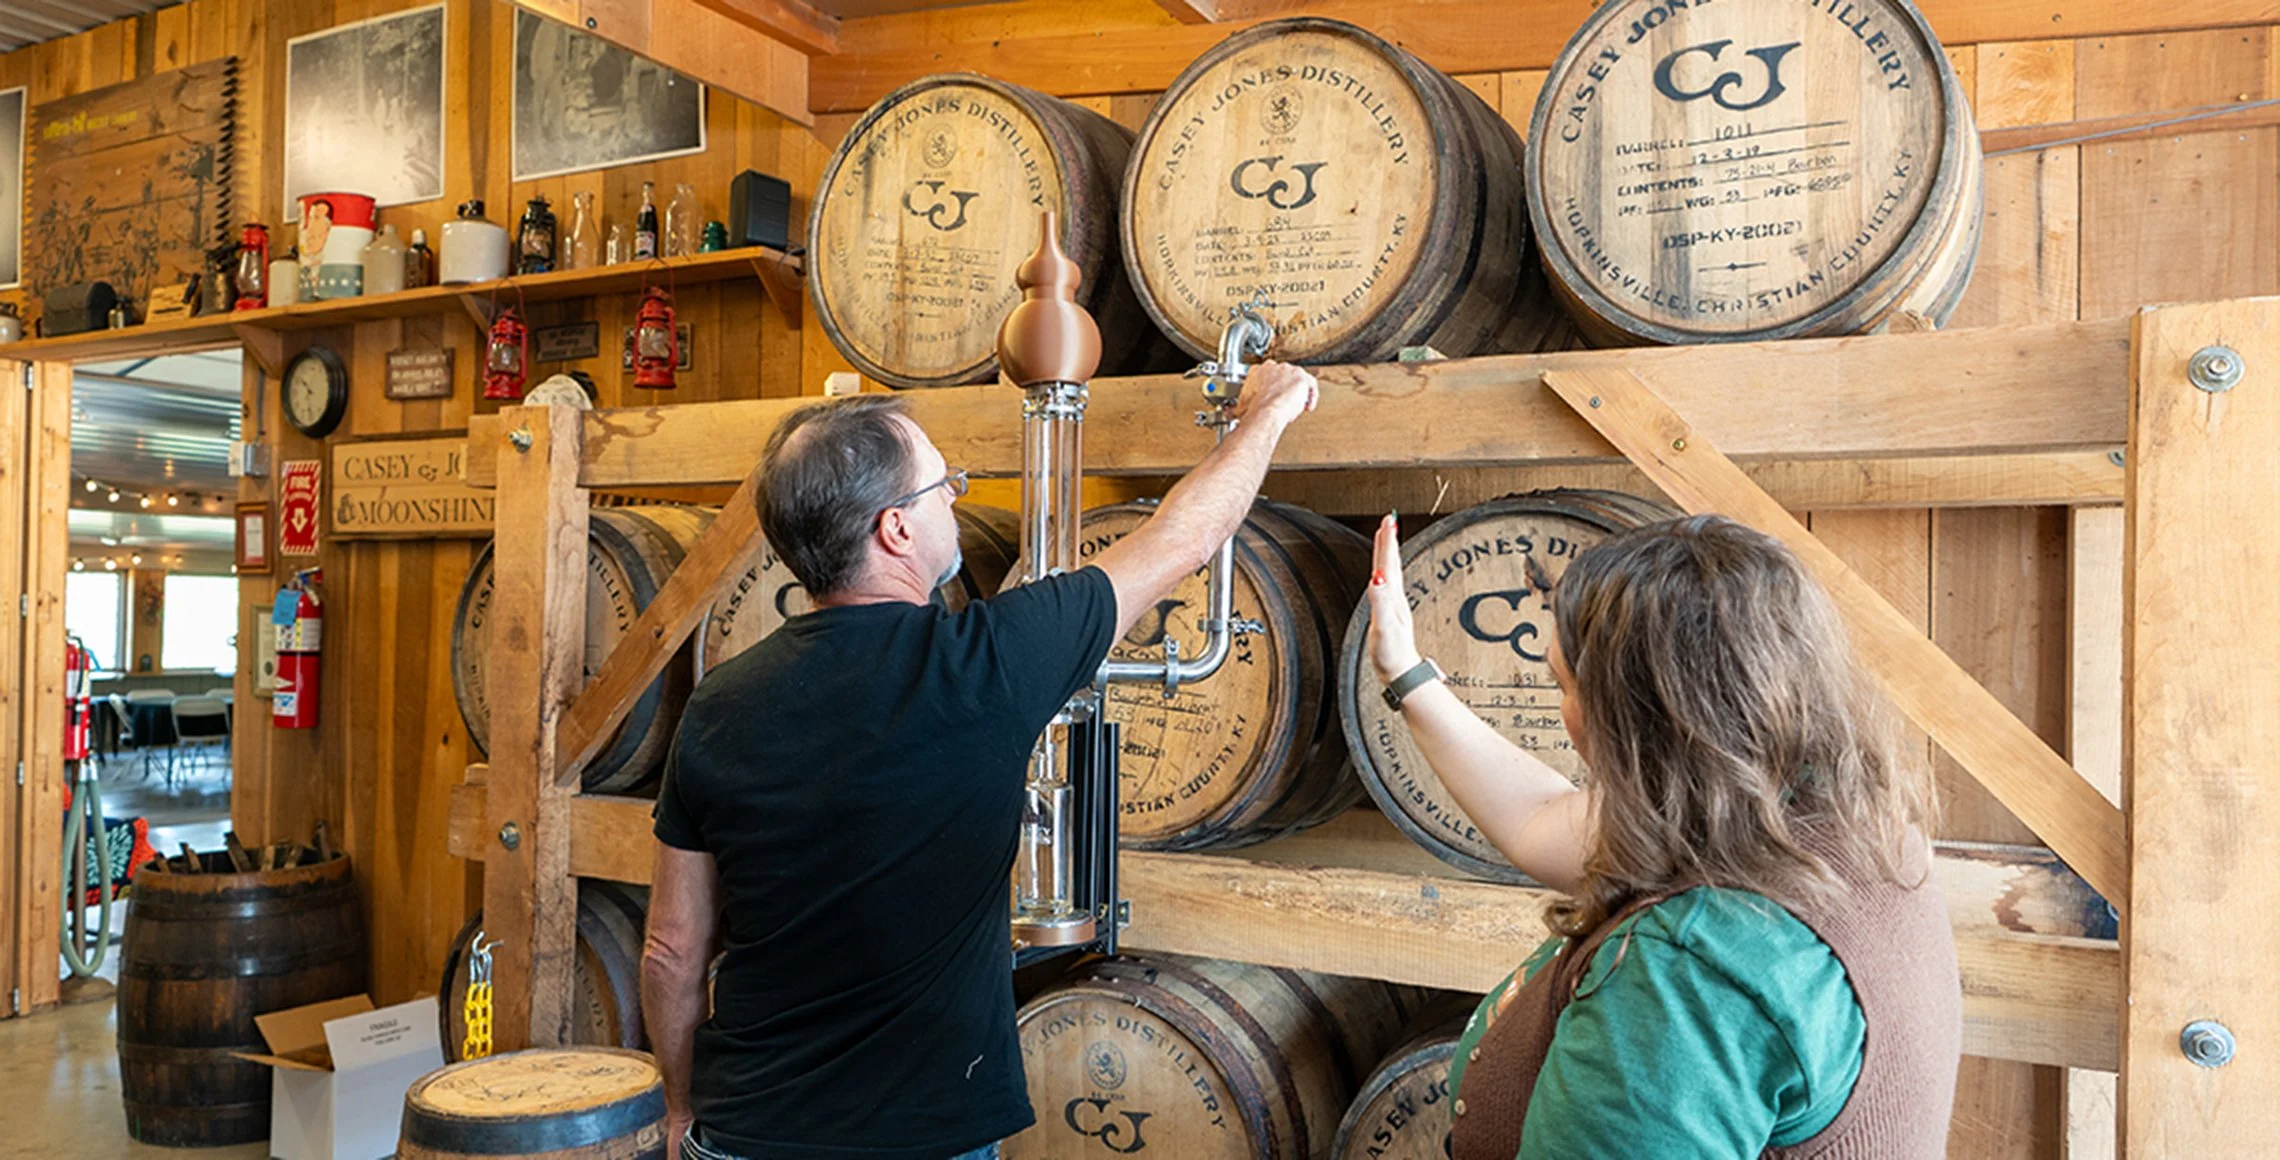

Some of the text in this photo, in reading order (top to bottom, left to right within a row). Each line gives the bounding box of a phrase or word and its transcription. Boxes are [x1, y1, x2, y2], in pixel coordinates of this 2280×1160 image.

[1561, 0, 1910, 143] CASEY JON ILLERY
[1653, 39, 1802, 111] CJ
[845, 99, 1044, 207] CASEY JONES DISTILLERY
[1159, 65, 1409, 191] CASEY JONES DISTILLERY
[902, 180, 980, 232] CJ
[1231, 155, 1328, 210] CJ
[1393, 213, 1406, 236] KY
[1696, 271, 1824, 313] CHRISTIAN
[1893, 151, 1912, 178] KY
[344, 453, 414, 480] CASEY
[588, 553, 630, 632] TILLERY
[1436, 534, 1533, 581] JONES
[719, 569, 758, 637] CASEY
[1120, 793, 1176, 815] STIAN
[1232, 714, 1247, 739] KY
[1039, 1011, 1228, 1131] JONES DISTILLERY
[1065, 1097, 1152, 1153] CJ
[1366, 1097, 1416, 1160] ASEY
